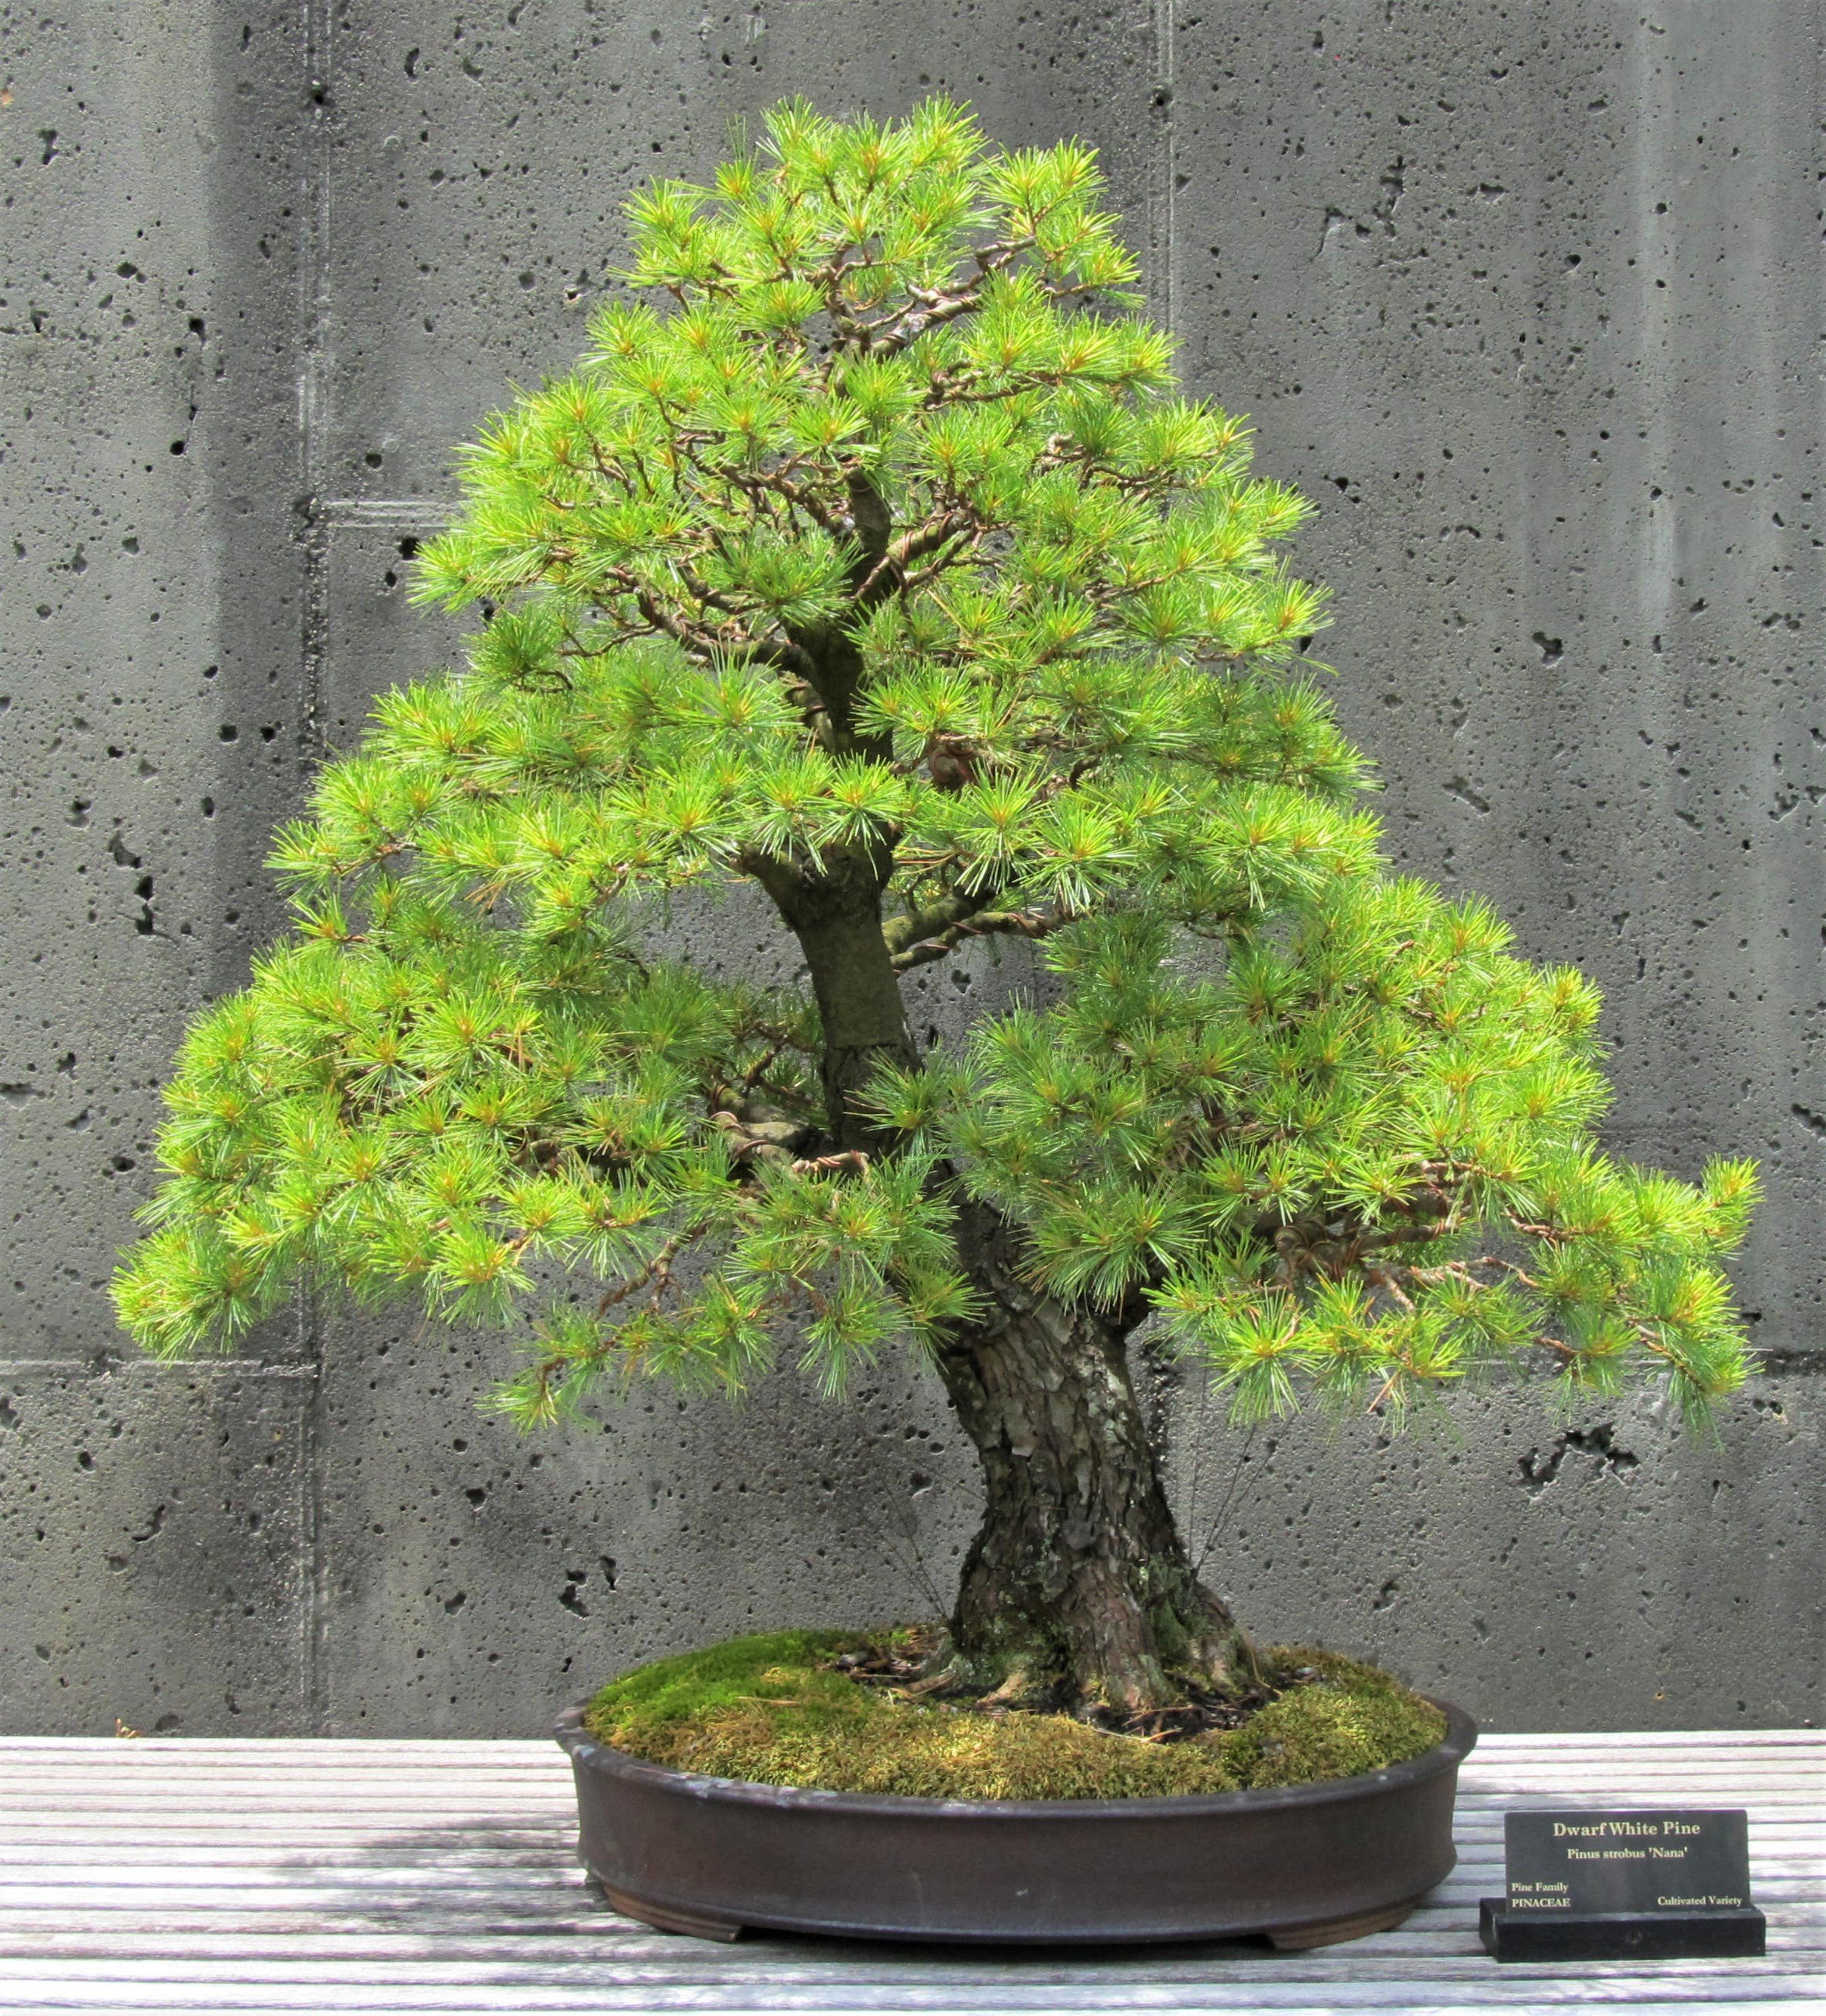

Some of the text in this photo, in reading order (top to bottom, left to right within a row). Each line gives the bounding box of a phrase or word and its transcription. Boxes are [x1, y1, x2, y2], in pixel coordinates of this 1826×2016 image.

[1553, 1822, 1700, 1837] Dwarf White Pine
[1567, 1849, 1600, 1859] Pinus
[1603, 1848, 1645, 1858] strobus
[1511, 1882, 1568, 1893] Pine Family
[1511, 1899, 1570, 1907] PINACEAE
[1657, 1896, 1742, 1907] Cultivated Variety
